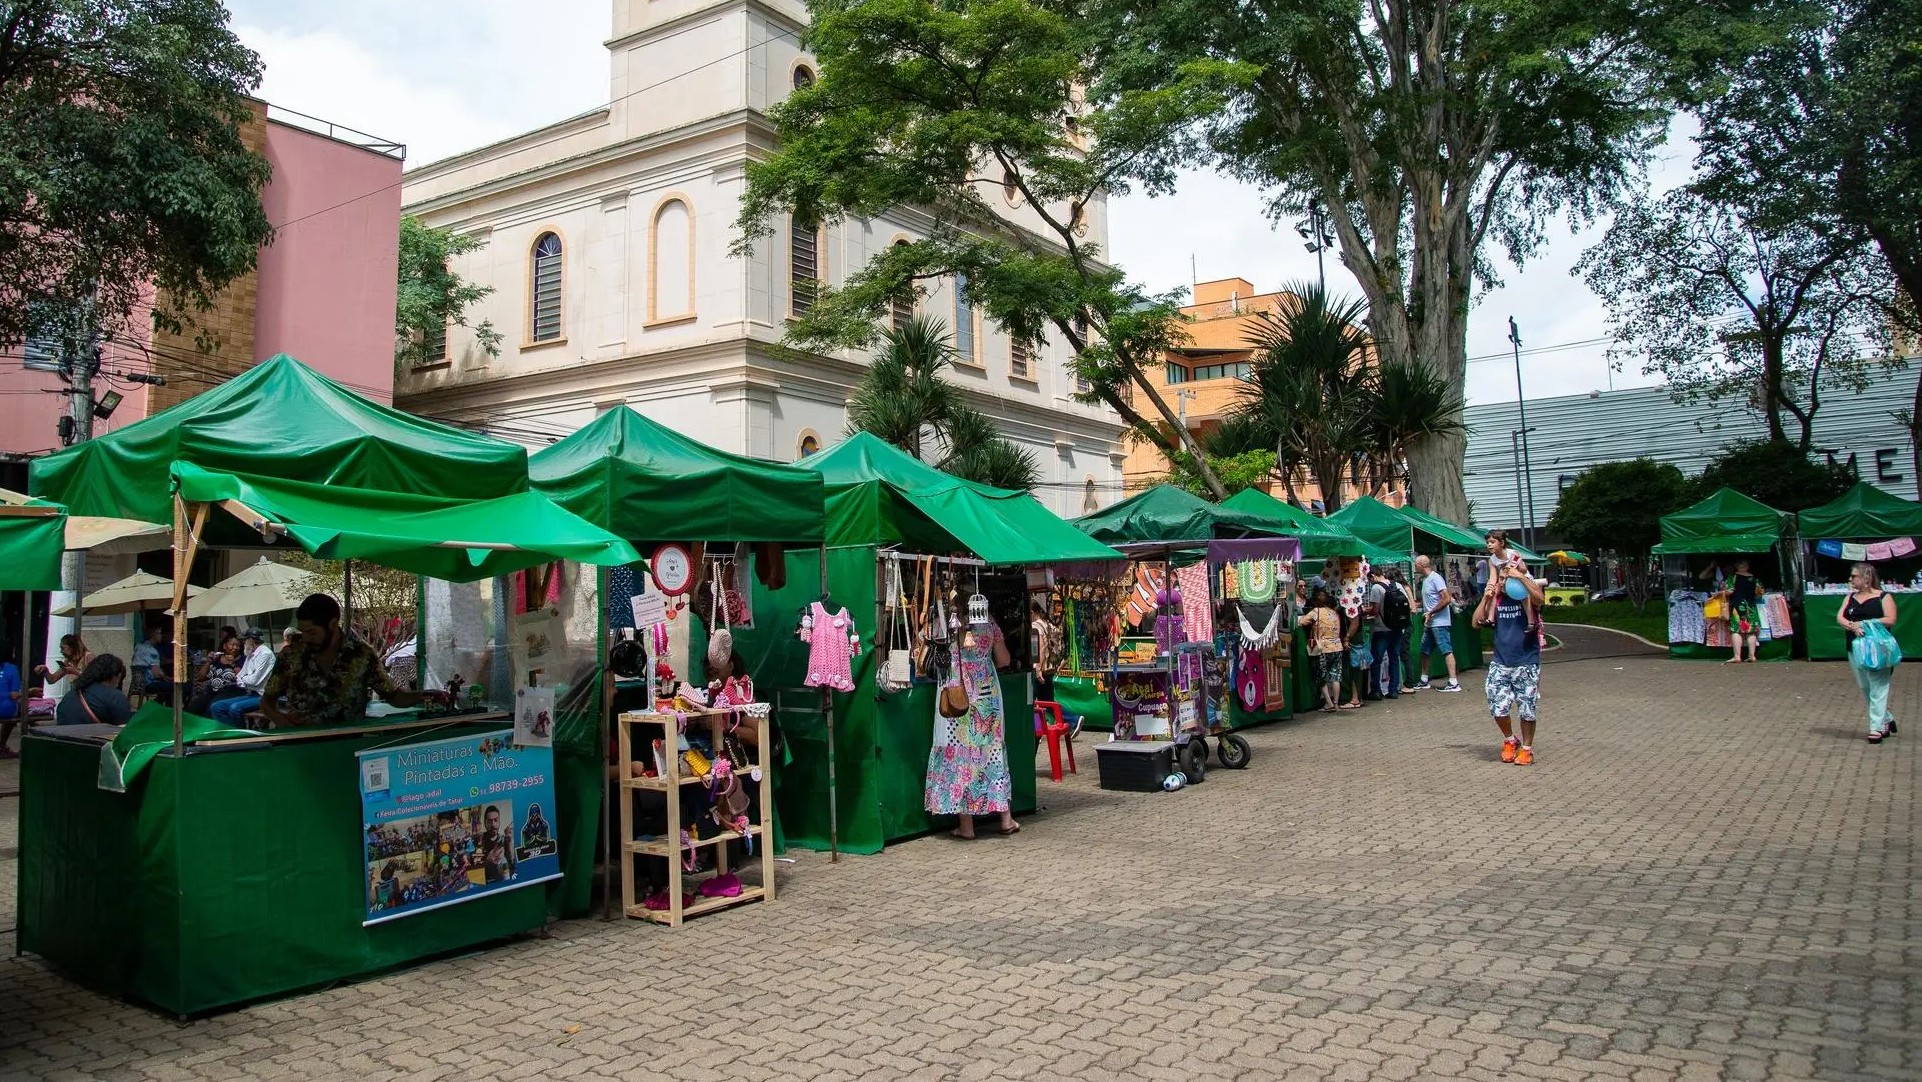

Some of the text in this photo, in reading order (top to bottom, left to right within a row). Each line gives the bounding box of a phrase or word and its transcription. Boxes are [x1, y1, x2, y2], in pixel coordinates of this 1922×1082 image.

[397, 746, 473, 769] Miniaturas
[405, 756, 518, 785] Pintadas a Mão.
[489, 774, 544, 794] 98739-2955
